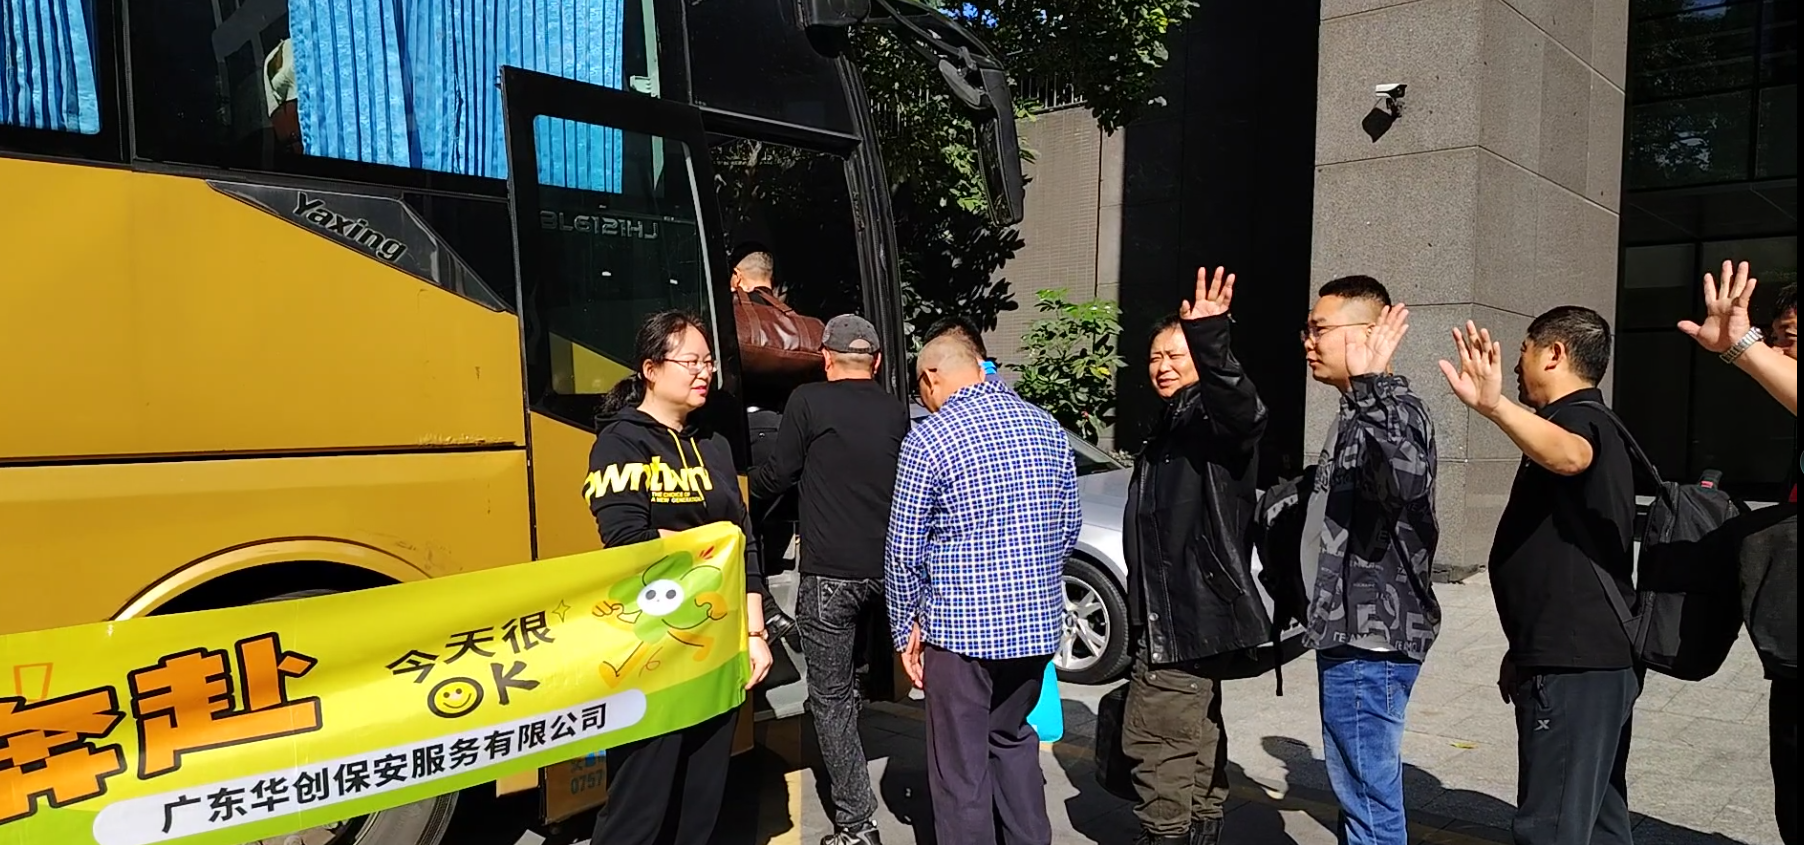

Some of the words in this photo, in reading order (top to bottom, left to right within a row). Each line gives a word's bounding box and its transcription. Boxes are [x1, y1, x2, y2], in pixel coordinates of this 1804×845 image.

[292, 191, 408, 263] Yaxing
[385, 610, 554, 684] 今天很
[427, 660, 540, 718] OK
[0, 632, 322, 825] 奔赴
[161, 702, 607, 833] 广东华创保安服务有限公司
